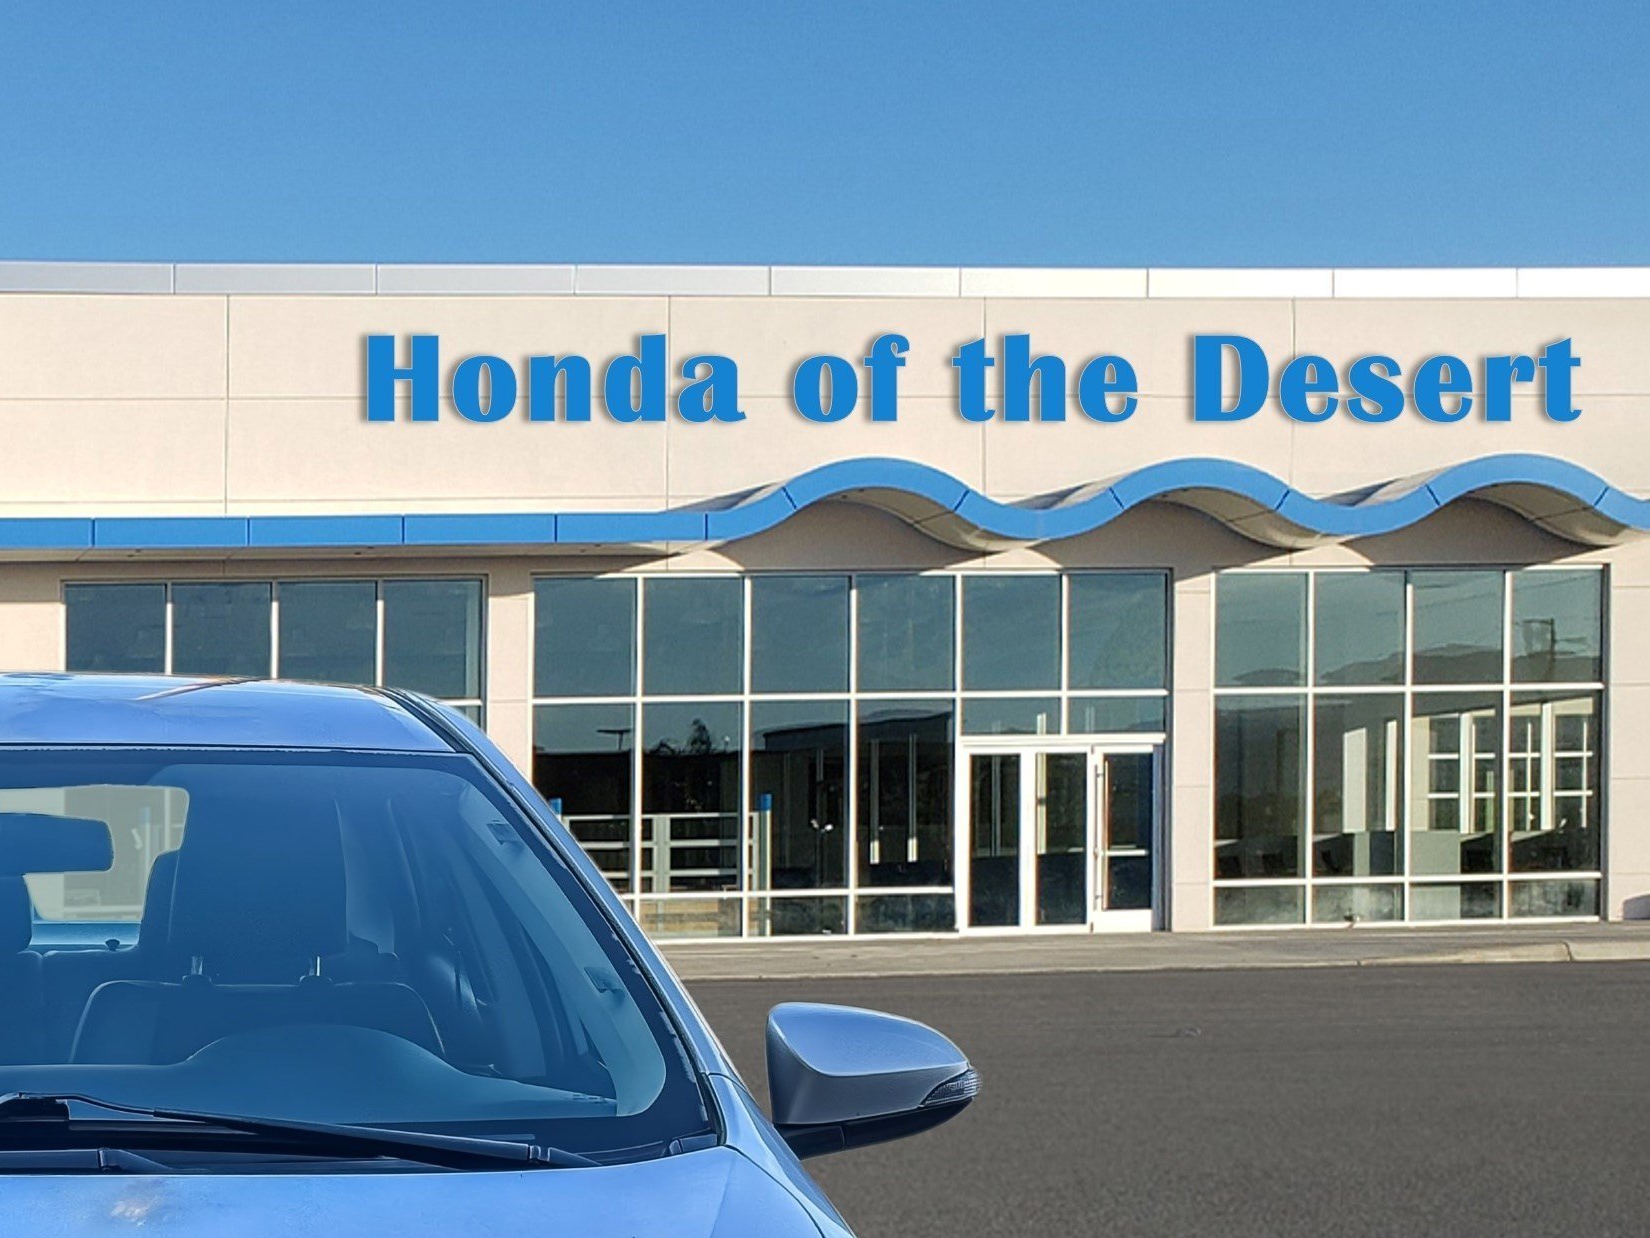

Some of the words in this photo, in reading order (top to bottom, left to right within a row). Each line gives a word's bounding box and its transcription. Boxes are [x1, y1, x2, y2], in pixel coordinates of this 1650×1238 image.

[366, 333, 747, 423] Honda
[793, 333, 910, 423] of
[951, 333, 1138, 423] the
[1194, 334, 1582, 423] Desert
